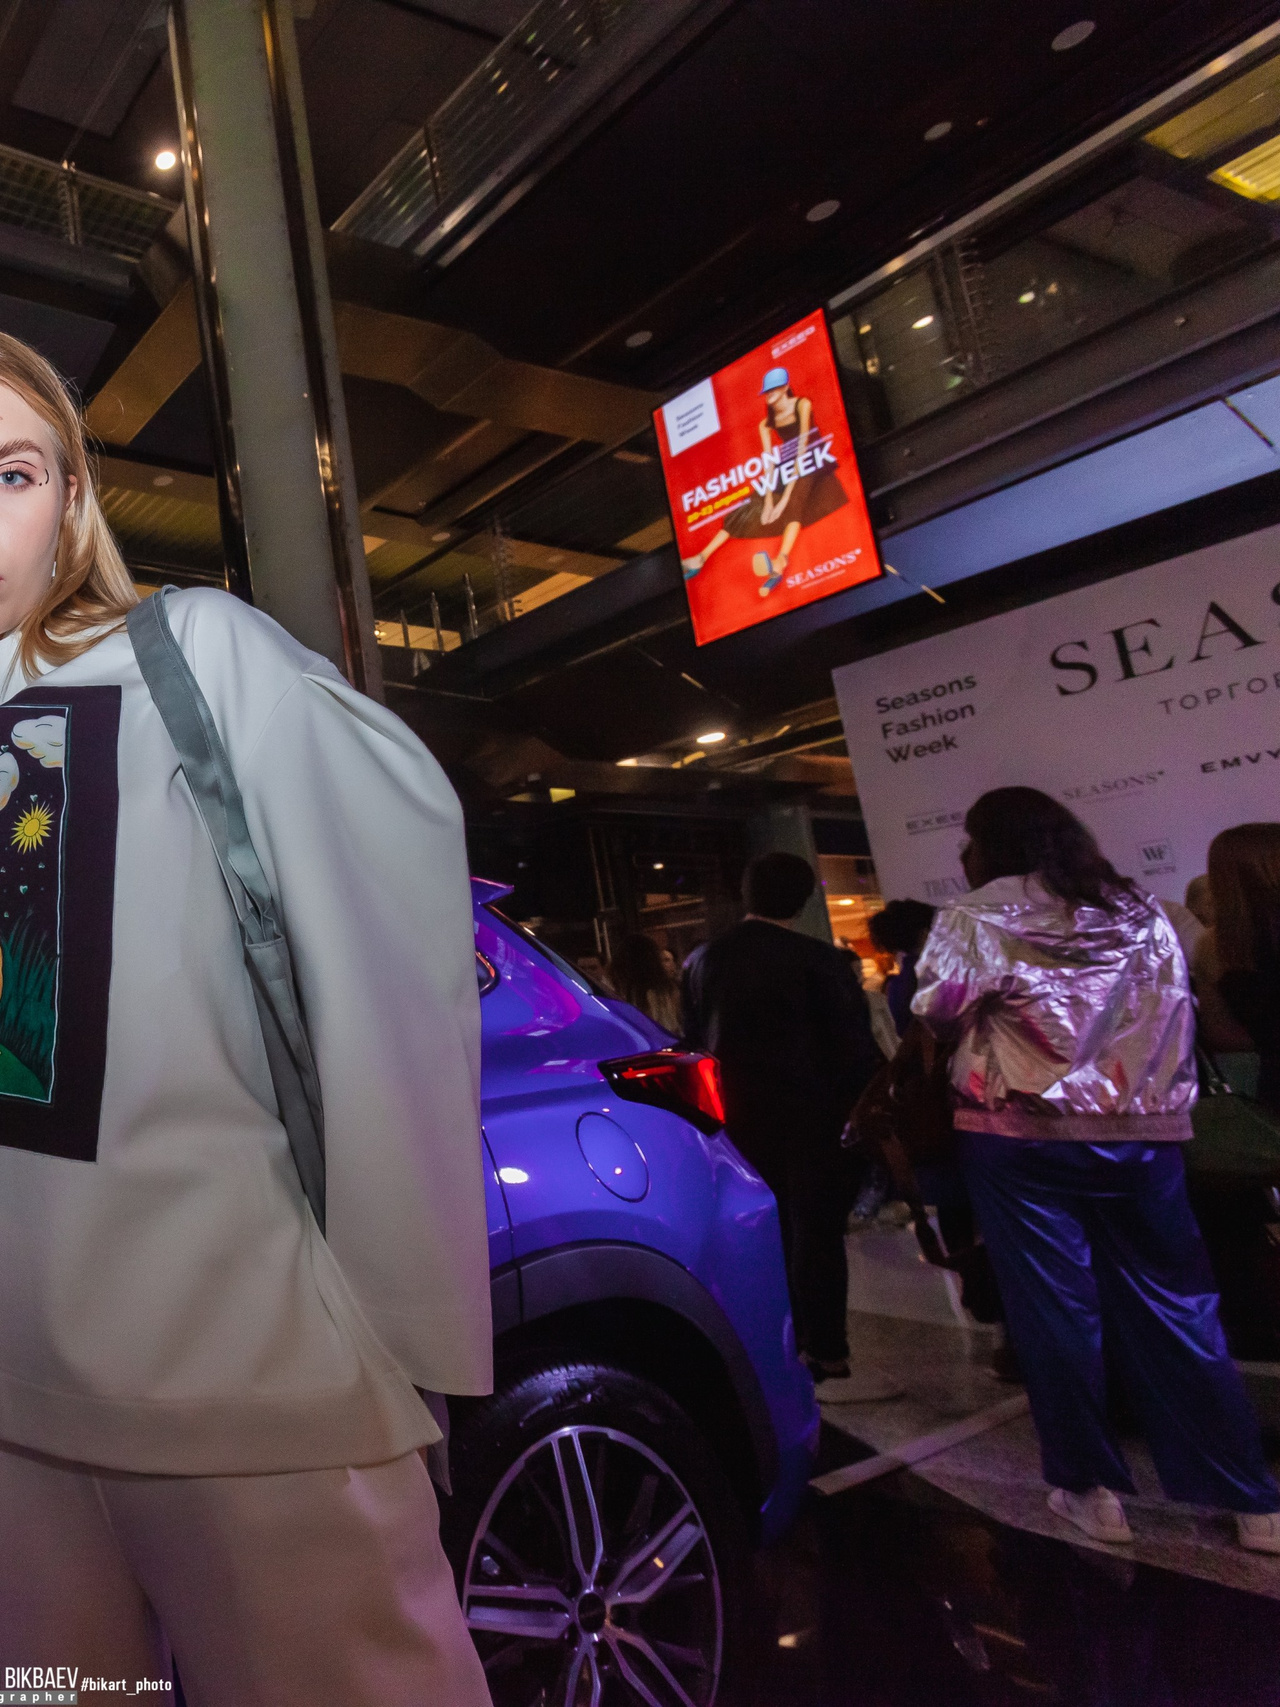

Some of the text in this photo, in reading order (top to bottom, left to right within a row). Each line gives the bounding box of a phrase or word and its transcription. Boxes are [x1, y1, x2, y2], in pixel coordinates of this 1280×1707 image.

[681, 446, 781, 512] FASHION
[751, 440, 837, 497] WEEK
[1050, 582, 1280, 697] SEA
[876, 676, 977, 714] Seasons
[882, 704, 975, 739] Fashion
[886, 734, 958, 763] Week
